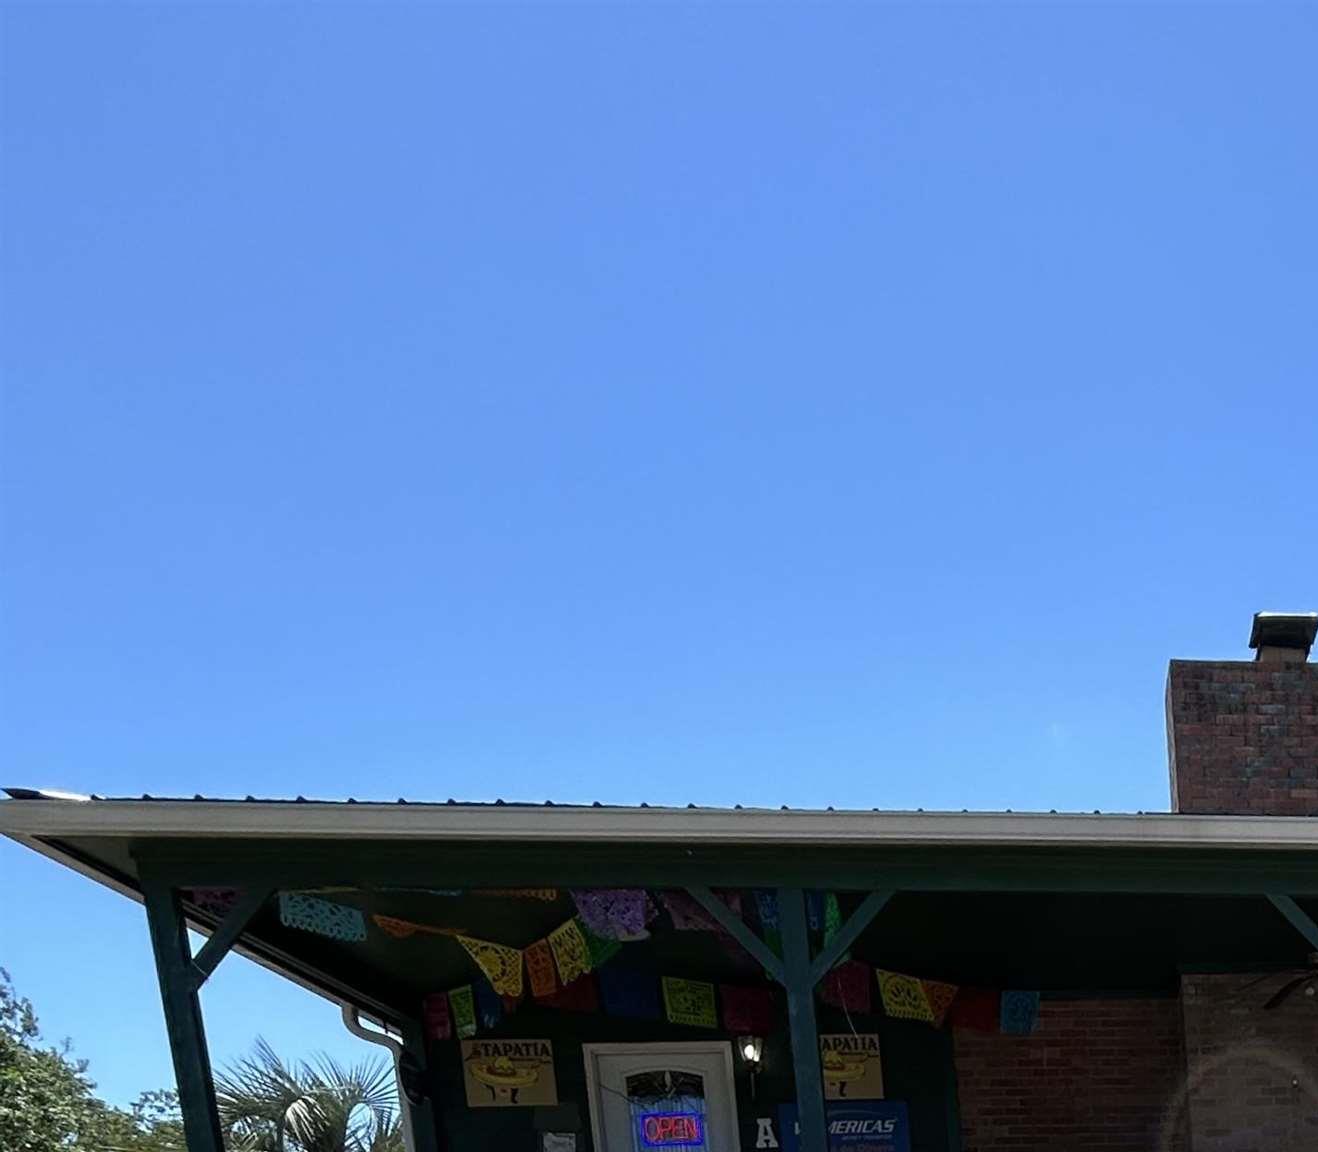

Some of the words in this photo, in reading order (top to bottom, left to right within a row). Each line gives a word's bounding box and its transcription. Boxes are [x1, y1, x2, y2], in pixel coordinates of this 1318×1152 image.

[823, 1037, 878, 1051] APATIA
[644, 1115, 698, 1142] OPEN
[756, 1117, 779, 1149] A
